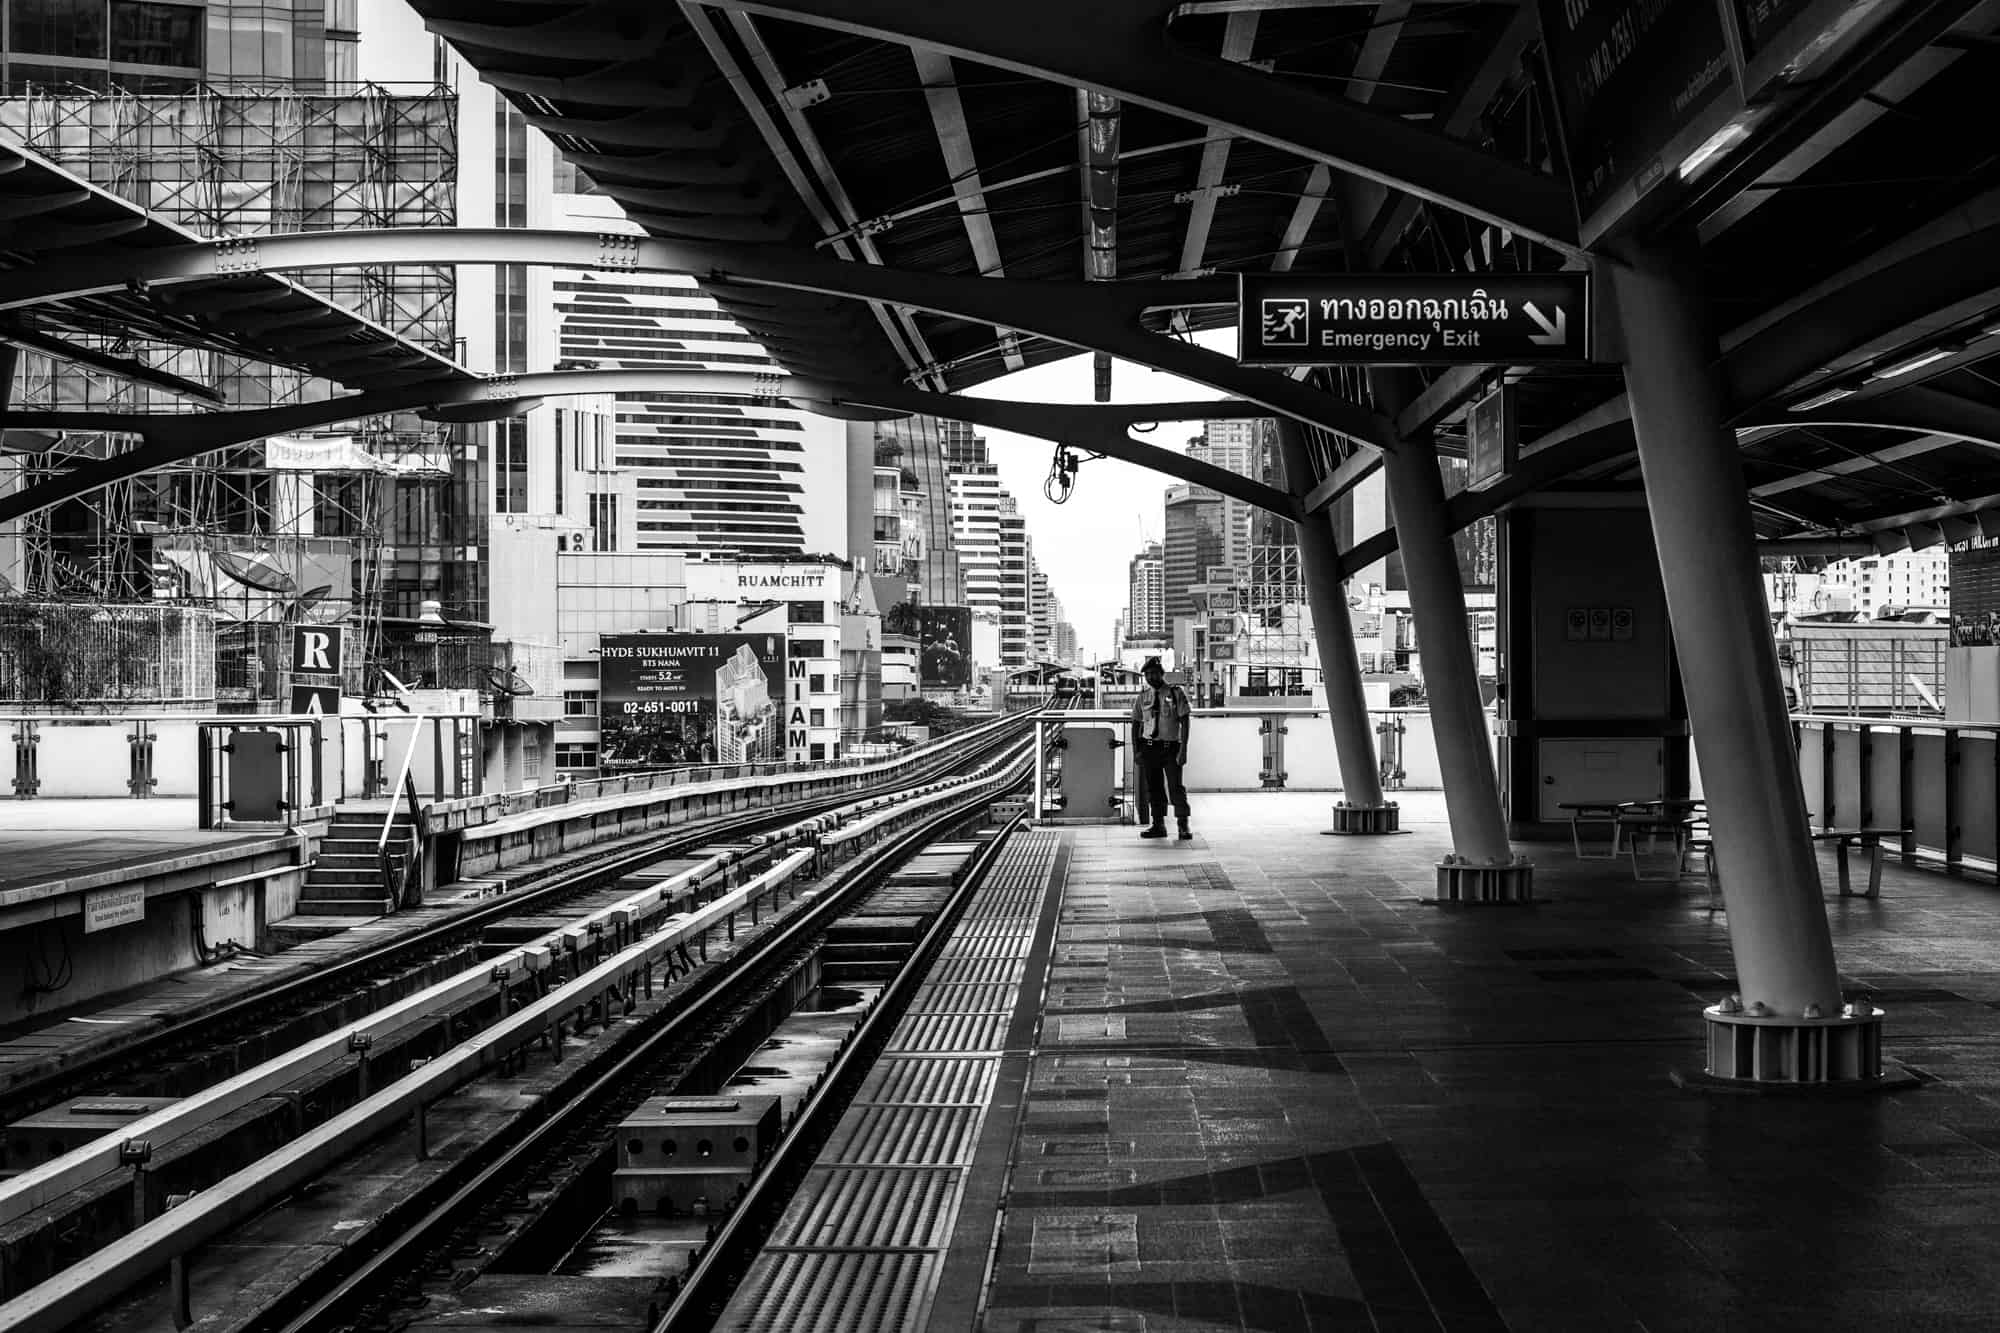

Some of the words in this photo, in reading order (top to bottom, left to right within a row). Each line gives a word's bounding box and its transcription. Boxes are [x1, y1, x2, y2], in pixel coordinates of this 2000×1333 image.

[1320, 288, 1508, 331] ทางออกฉุกเฉิน
[1321, 330, 1431, 351] Emergency
[1442, 329, 1480, 347] Exit
[737, 575, 825, 587] RUAMCHITT
[602, 646, 634, 658] HYDE
[636, 646, 706, 657] SUKHUMVIT
[707, 646, 720, 657] 11
[657, 659, 681, 667] NANA
[623, 701, 699, 714] 02-651-0011
